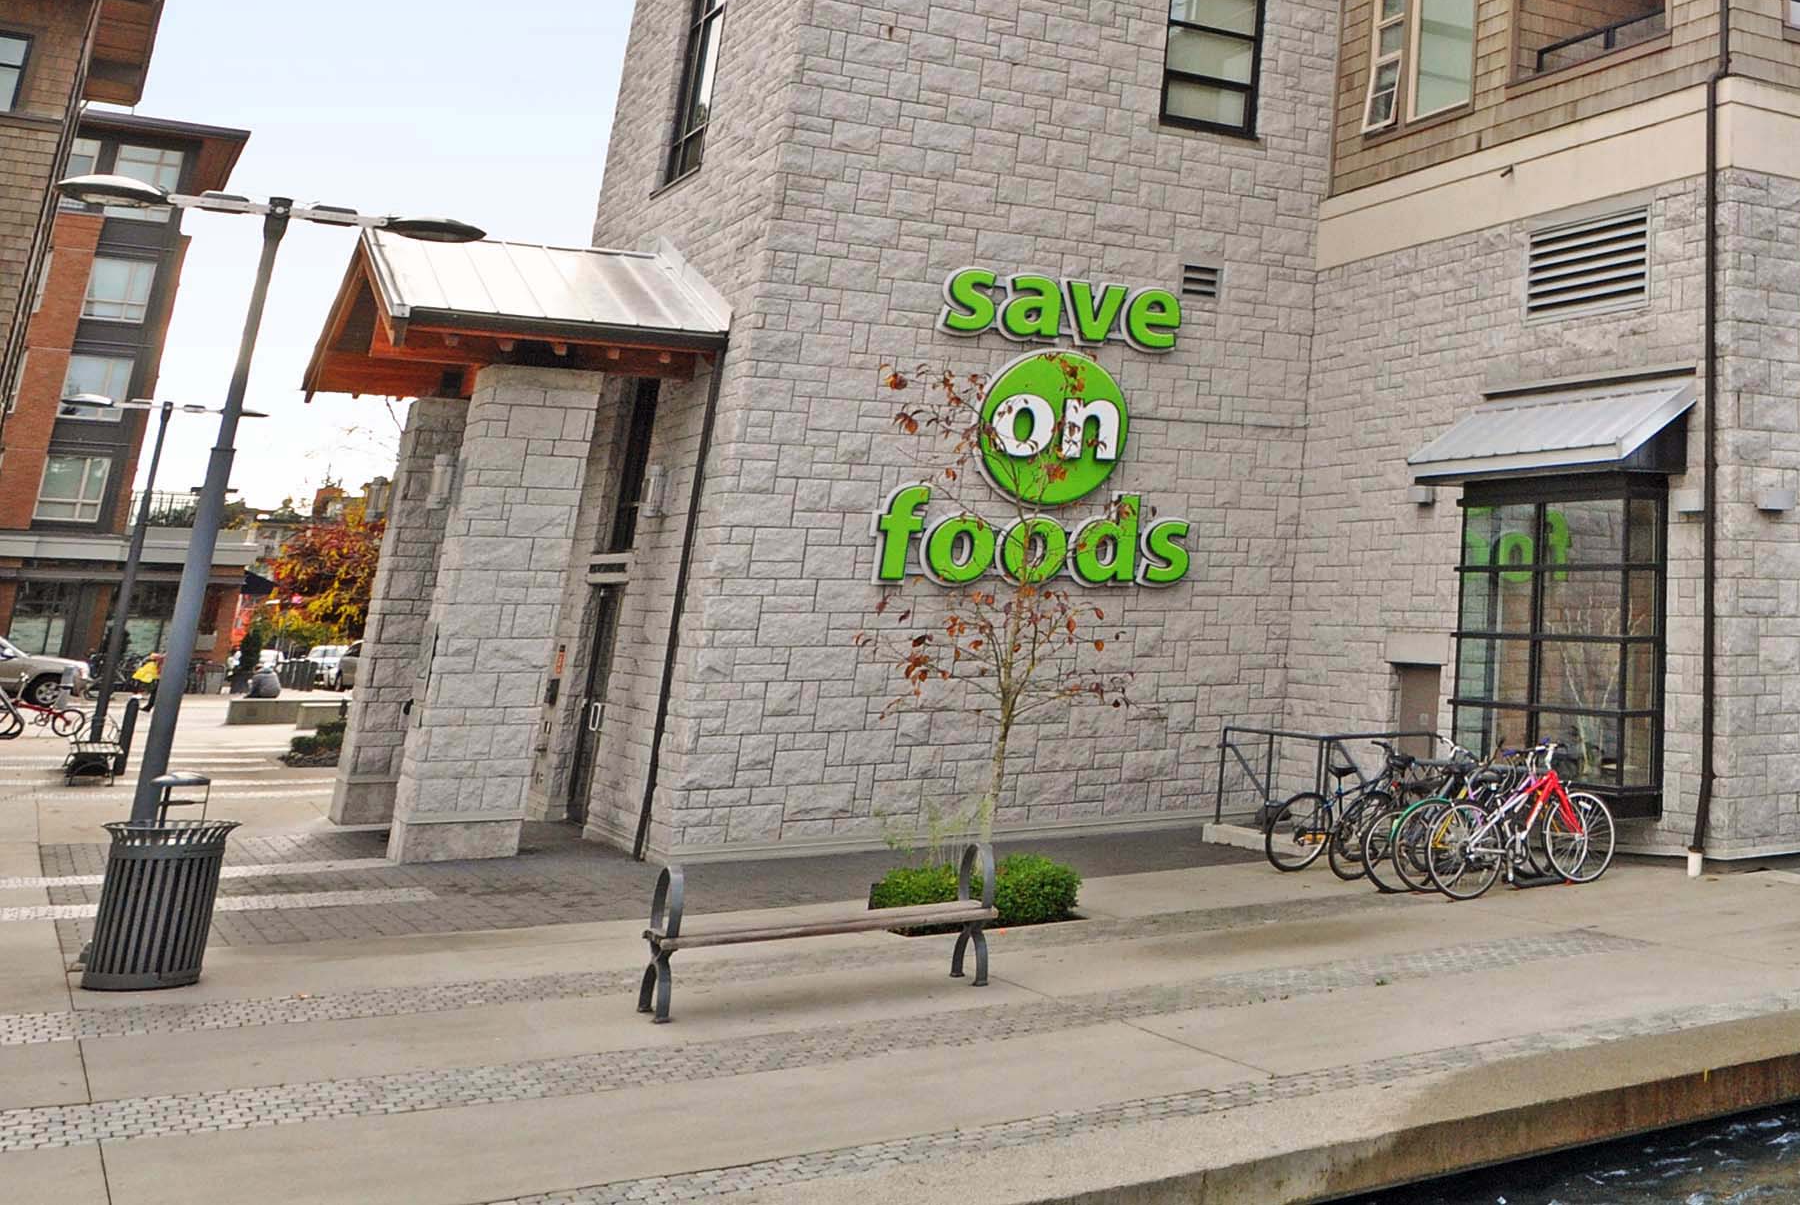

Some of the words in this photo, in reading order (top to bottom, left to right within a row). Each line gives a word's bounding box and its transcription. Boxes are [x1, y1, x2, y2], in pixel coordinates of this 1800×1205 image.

[945, 268, 1183, 349] save
[991, 393, 1120, 461] on
[878, 485, 1190, 584] foods
